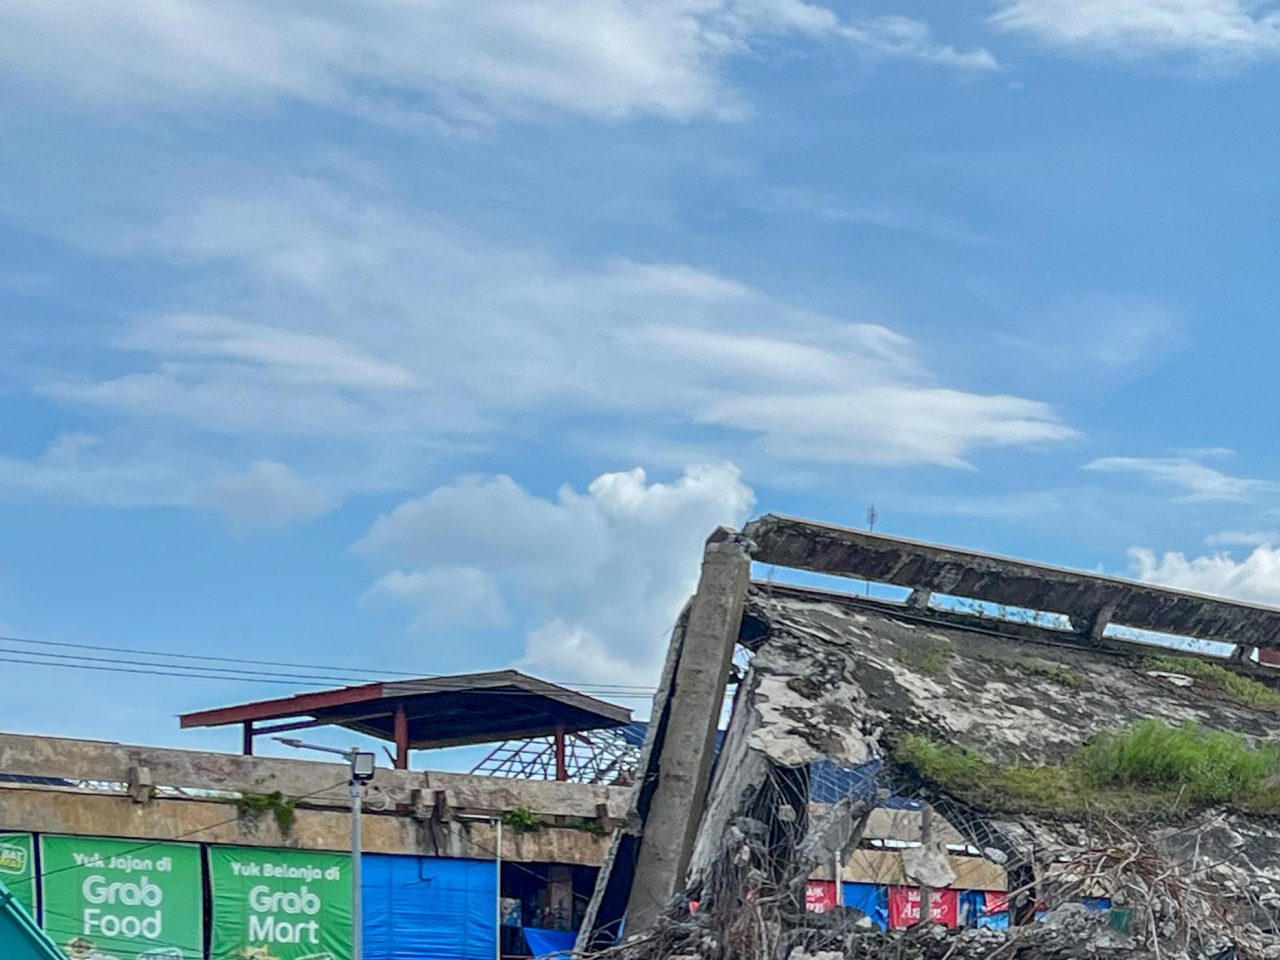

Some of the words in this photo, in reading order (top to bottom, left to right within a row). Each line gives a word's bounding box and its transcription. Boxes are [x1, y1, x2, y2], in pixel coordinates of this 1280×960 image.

[72, 852, 105, 869] Yuk
[108, 854, 153, 873] Jajan
[155, 856, 172, 872] di
[230, 861, 260, 877] Yuk
[263, 863, 322, 883] Belanja
[324, 865, 340, 881] di
[82, 874, 163, 907] Grab
[248, 884, 321, 915] Grab
[908, 890, 942, 903] MAUK
[900, 901, 949, 919] Anin?
[83, 908, 162, 939] Food
[248, 914, 320, 944] Mart
